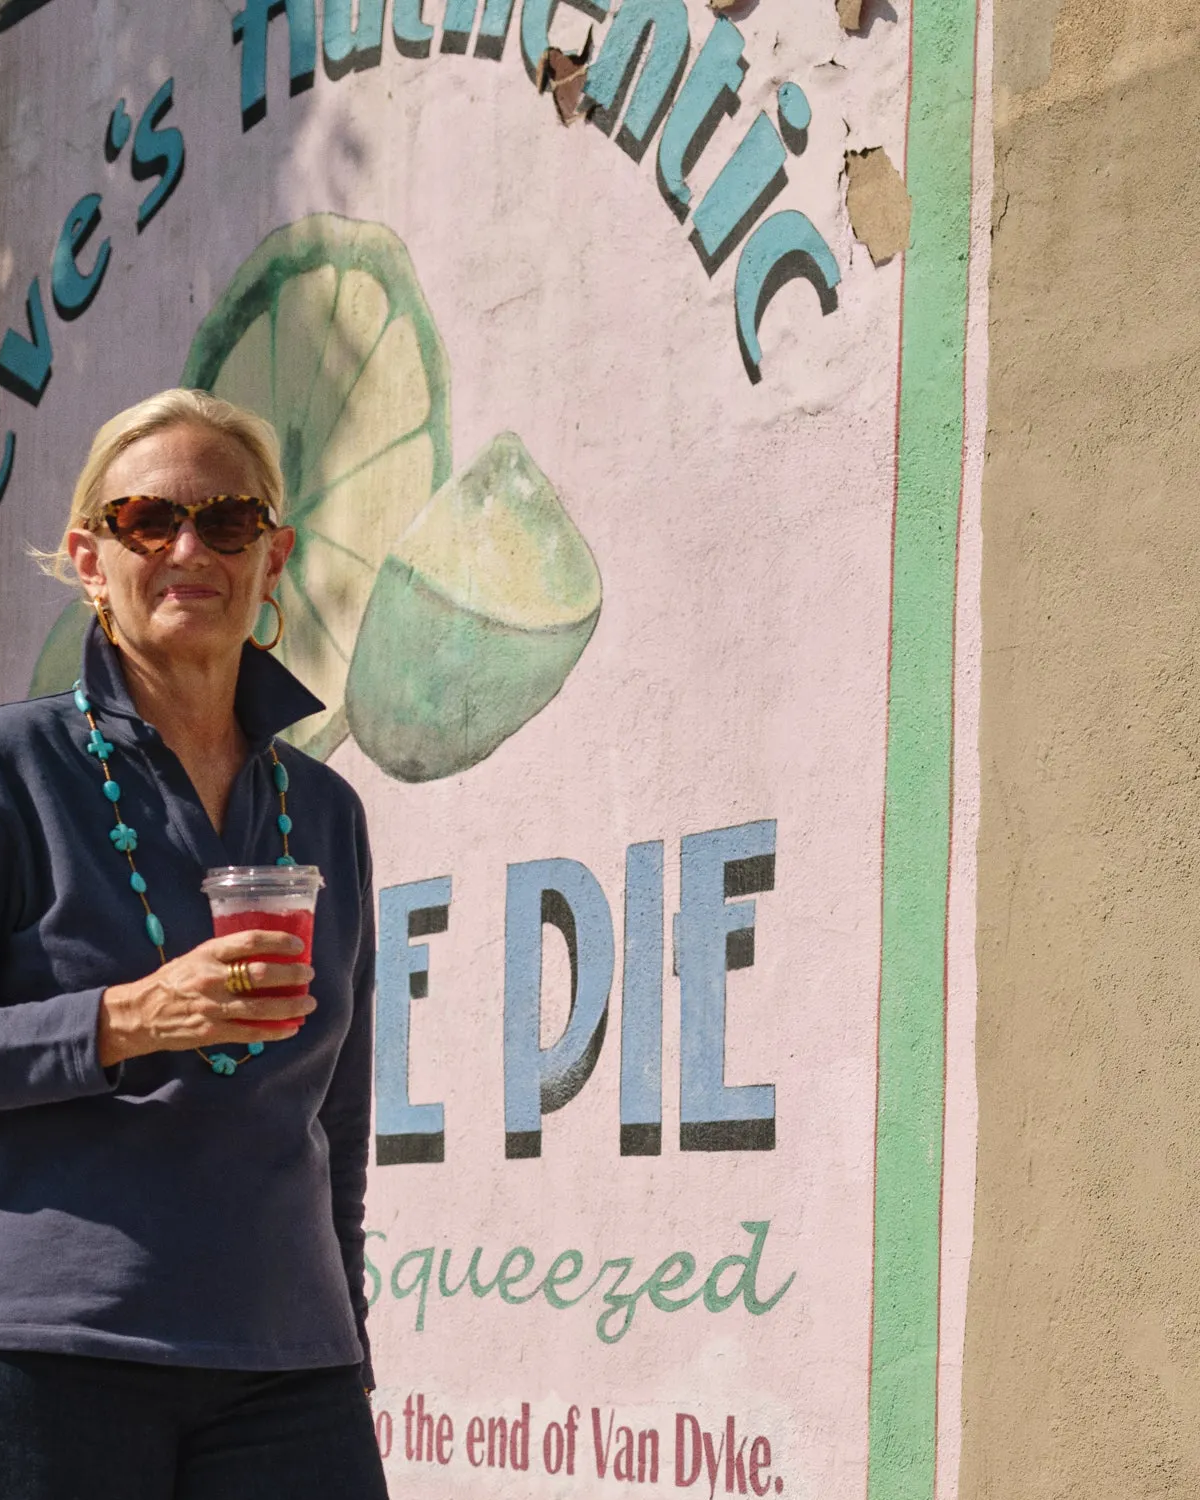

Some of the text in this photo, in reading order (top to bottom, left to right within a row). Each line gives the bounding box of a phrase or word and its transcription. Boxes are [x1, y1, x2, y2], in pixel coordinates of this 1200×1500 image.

[504, 818, 778, 1160] PIE
[373, 1410, 393, 1459] o
[403, 1393, 454, 1465] the
[466, 1402, 531, 1472] end
[543, 1404, 580, 1476] of
[591, 1407, 659, 1483] Van
